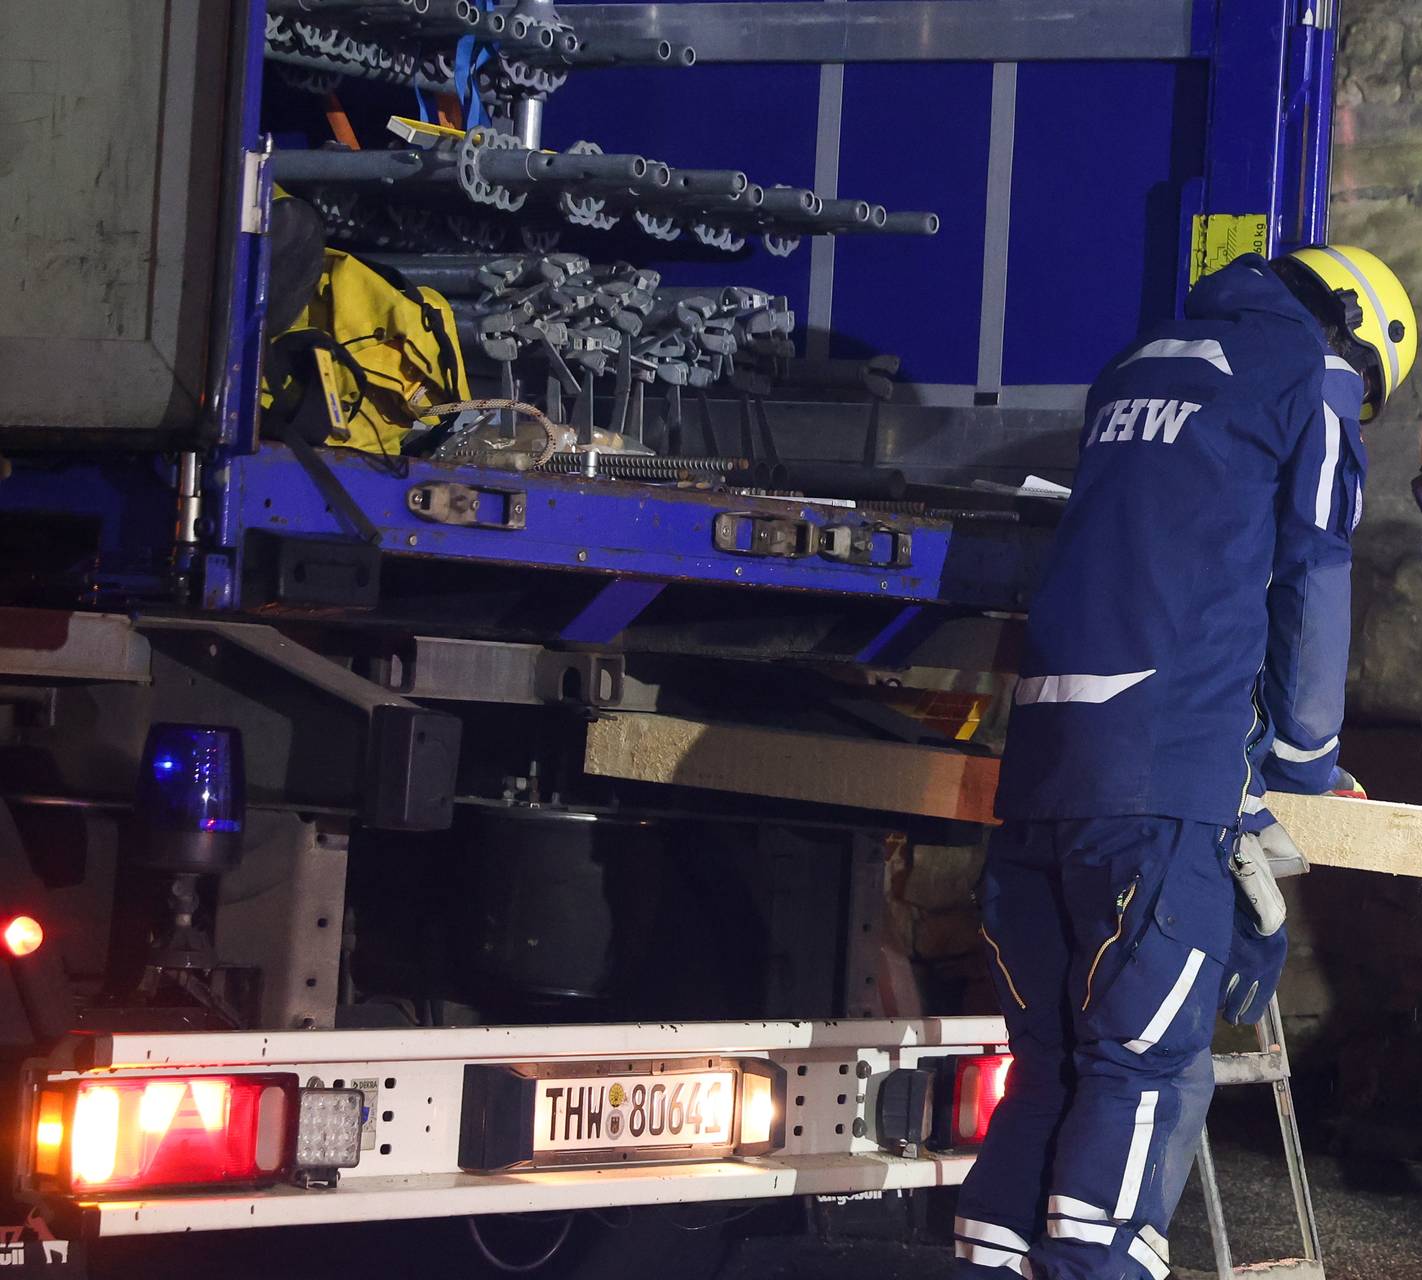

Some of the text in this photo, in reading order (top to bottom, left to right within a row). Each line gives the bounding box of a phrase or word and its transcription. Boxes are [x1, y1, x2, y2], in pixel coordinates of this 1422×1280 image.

[1253, 223, 1266, 253] 60 kg
[1086, 399, 1202, 447] THW
[546, 1082, 721, 1141] THW 80641
